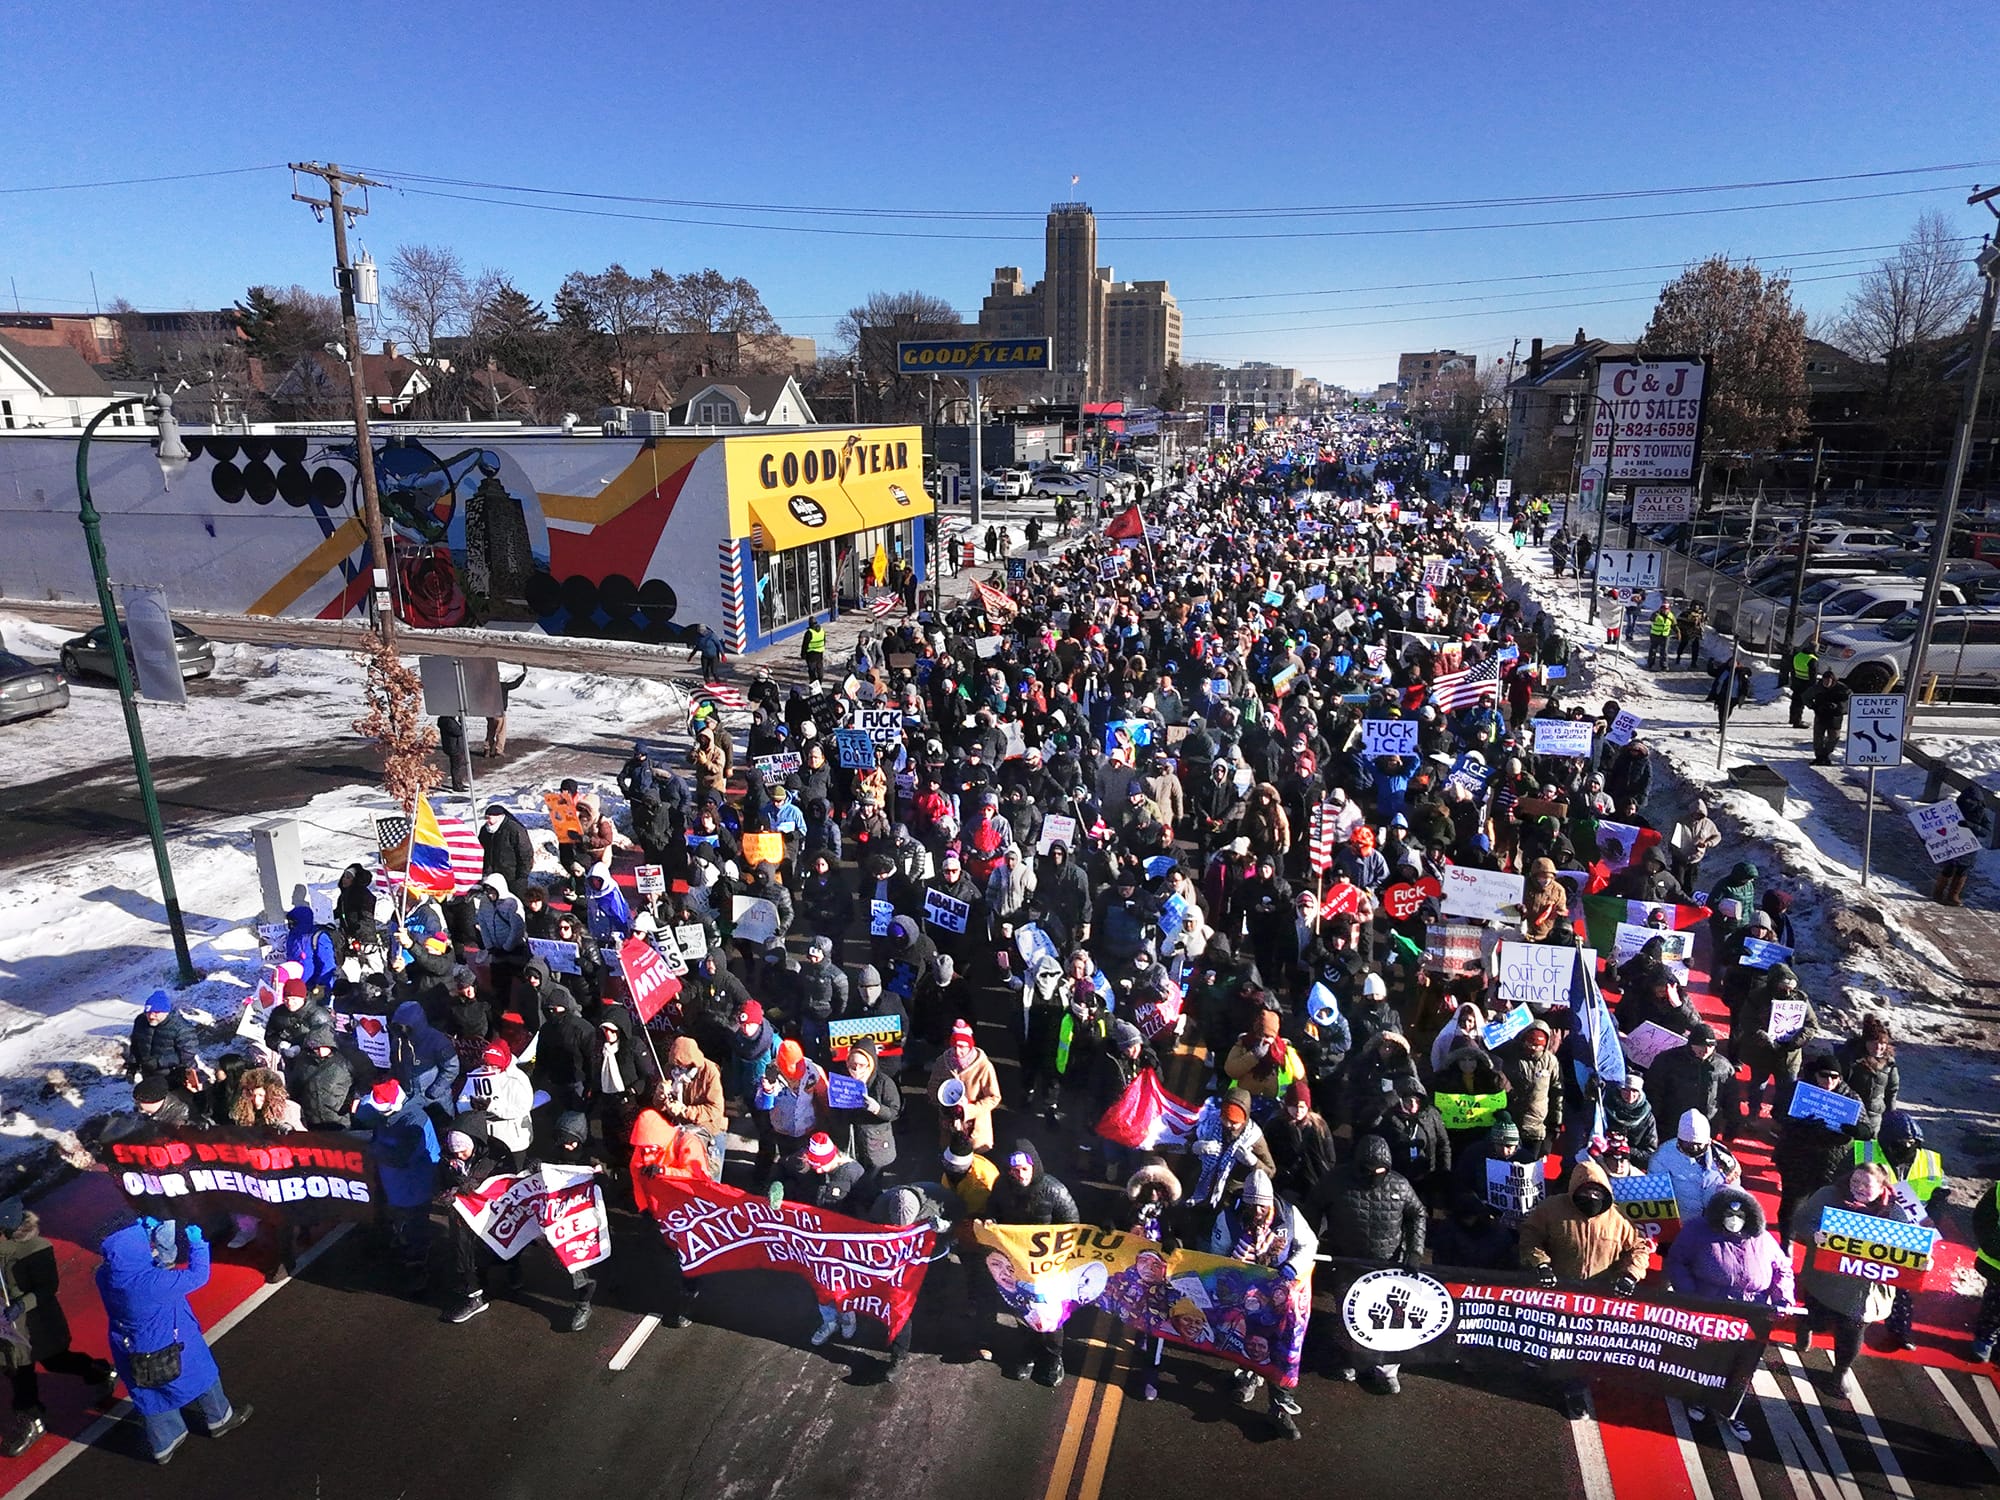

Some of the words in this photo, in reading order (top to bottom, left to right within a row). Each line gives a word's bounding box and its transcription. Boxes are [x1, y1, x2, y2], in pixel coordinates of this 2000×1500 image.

[1613, 369, 1637, 396] C
[1641, 373, 1660, 392] &
[1665, 369, 1689, 396] J
[1597, 400, 1640, 420] AUTO
[1645, 399, 1698, 420] SALES
[1592, 444, 1641, 457] JERY'S
[1644, 444, 1691, 458] TOWING
[1640, 487, 1688, 495] OAKLAND
[1642, 496, 1683, 504] AUTO
[1638, 503, 1686, 513] SALES
[1856, 698, 1898, 706] CENTER
[862, 711, 901, 728] FUCK
[1619, 714, 1635, 723] ICE
[1862, 707, 1891, 716] LANE
[1615, 719, 1634, 732] OUT
[842, 738, 869, 753] ICE
[772, 753, 799, 764] BLAME
[843, 751, 872, 766] OUT!
[1920, 807, 1940, 823] ICE
[1450, 869, 1478, 887] Stop
[1393, 885, 1427, 902] FUCK
[1395, 900, 1423, 917] ICE
[934, 908, 959, 930] ICE
[1520, 946, 1565, 968] ICE
[1502, 981, 1549, 1001] Native
[1776, 1002, 1788, 1010] WE
[1789, 1003, 1804, 1012] ARE
[472, 1078, 493, 1097] NO
[1454, 1099, 1480, 1109] VIVA
[113, 1142, 192, 1168] STOP
[196, 1143, 364, 1174] DEPORTING
[1510, 1164, 1525, 1179] NO
[122, 1171, 189, 1198] OUR
[190, 1169, 371, 1203] NEIGHBORS
[1625, 1200, 1675, 1219] OUT
[1029, 1227, 1126, 1258] SEIU
[1030, 1250, 1085, 1275] LOCAL
[1092, 1249, 1116, 1263] 26
[1869, 1243, 1928, 1268] OUT
[1839, 1256, 1900, 1281] MSP
[842, 1296, 892, 1327] MIRA
[1461, 1286, 1497, 1302] ALL
[1500, 1288, 1568, 1311] POWER
[1571, 1295, 1595, 1314] TO
[1600, 1299, 1638, 1320] THE
[1642, 1304, 1750, 1341] WORKERS!
[1498, 1305, 1512, 1319] EL
[1515, 1308, 1556, 1325] PODER
[1558, 1314, 1569, 1328] A
[1570, 1316, 1595, 1331] LOS
[1596, 1319, 1698, 1349] TRABAJADORES!
[1539, 1327, 1574, 1345] DHAN
[1575, 1333, 1661, 1355] SHAQAALAHA!
[1455, 1333, 1495, 1347] TXHUA
[1497, 1337, 1521, 1351] LUB
[1524, 1341, 1549, 1358] ZOG
[1550, 1347, 1575, 1361] RAU
[1576, 1351, 1601, 1365] COV
[1603, 1353, 1637, 1369] NEEG
[1638, 1358, 1656, 1372] UA
[1658, 1361, 1729, 1389] HAUJLWM!
